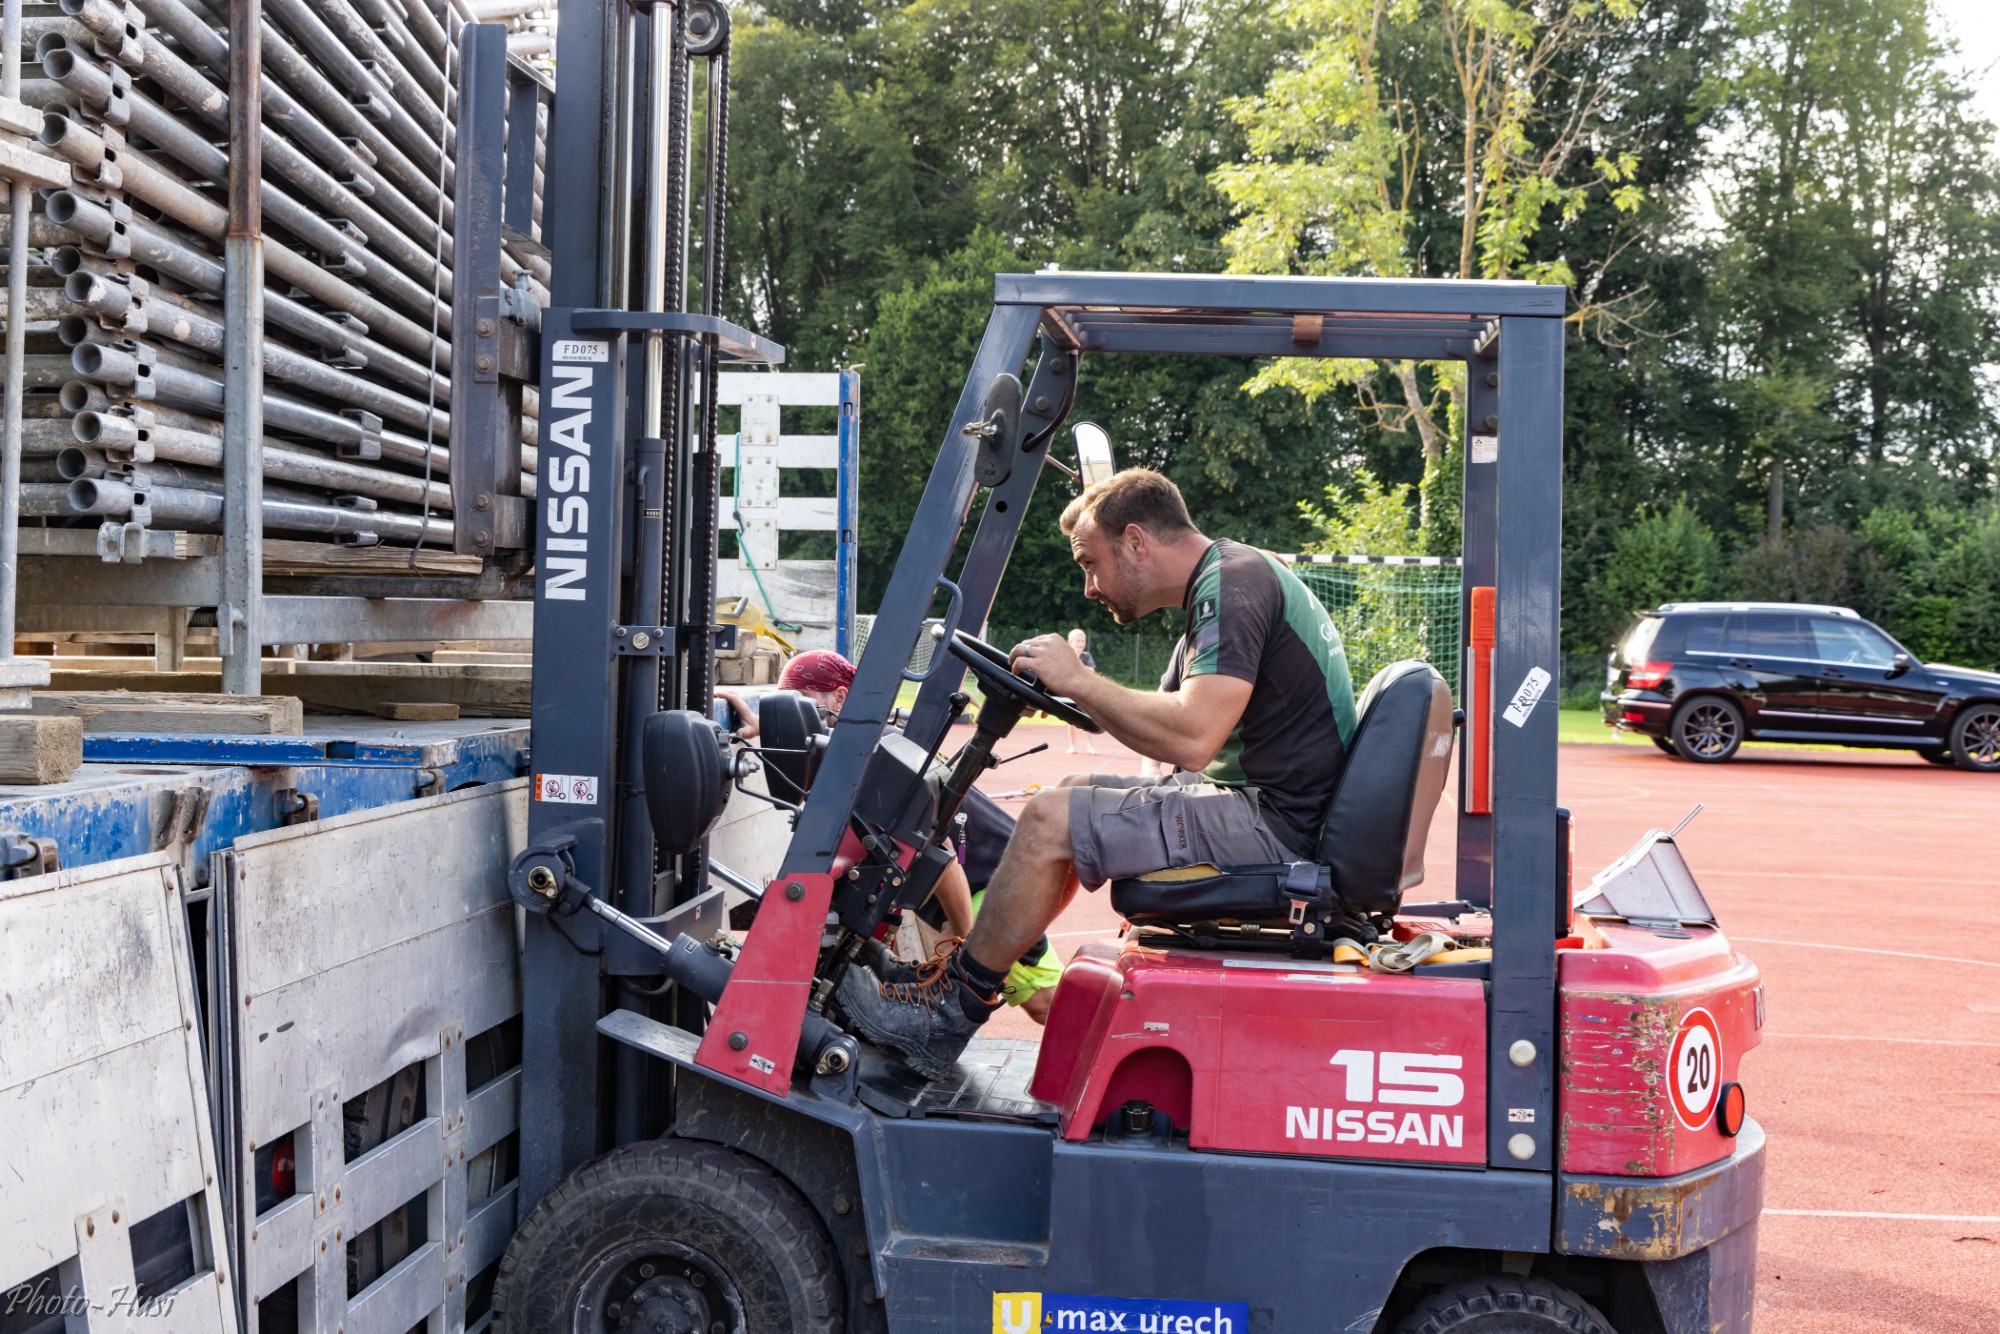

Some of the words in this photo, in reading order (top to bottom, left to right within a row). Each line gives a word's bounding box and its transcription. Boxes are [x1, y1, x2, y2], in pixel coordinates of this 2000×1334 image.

[563, 344, 598, 355] FD075
[545, 365, 594, 601] NISSAN
[1329, 1049, 1464, 1107] 15
[1686, 1043, 1711, 1094] 20
[1285, 1106, 1464, 1148] NISSAN
[1057, 1308, 1127, 1331] max
[1140, 1307, 1233, 1334] urech
